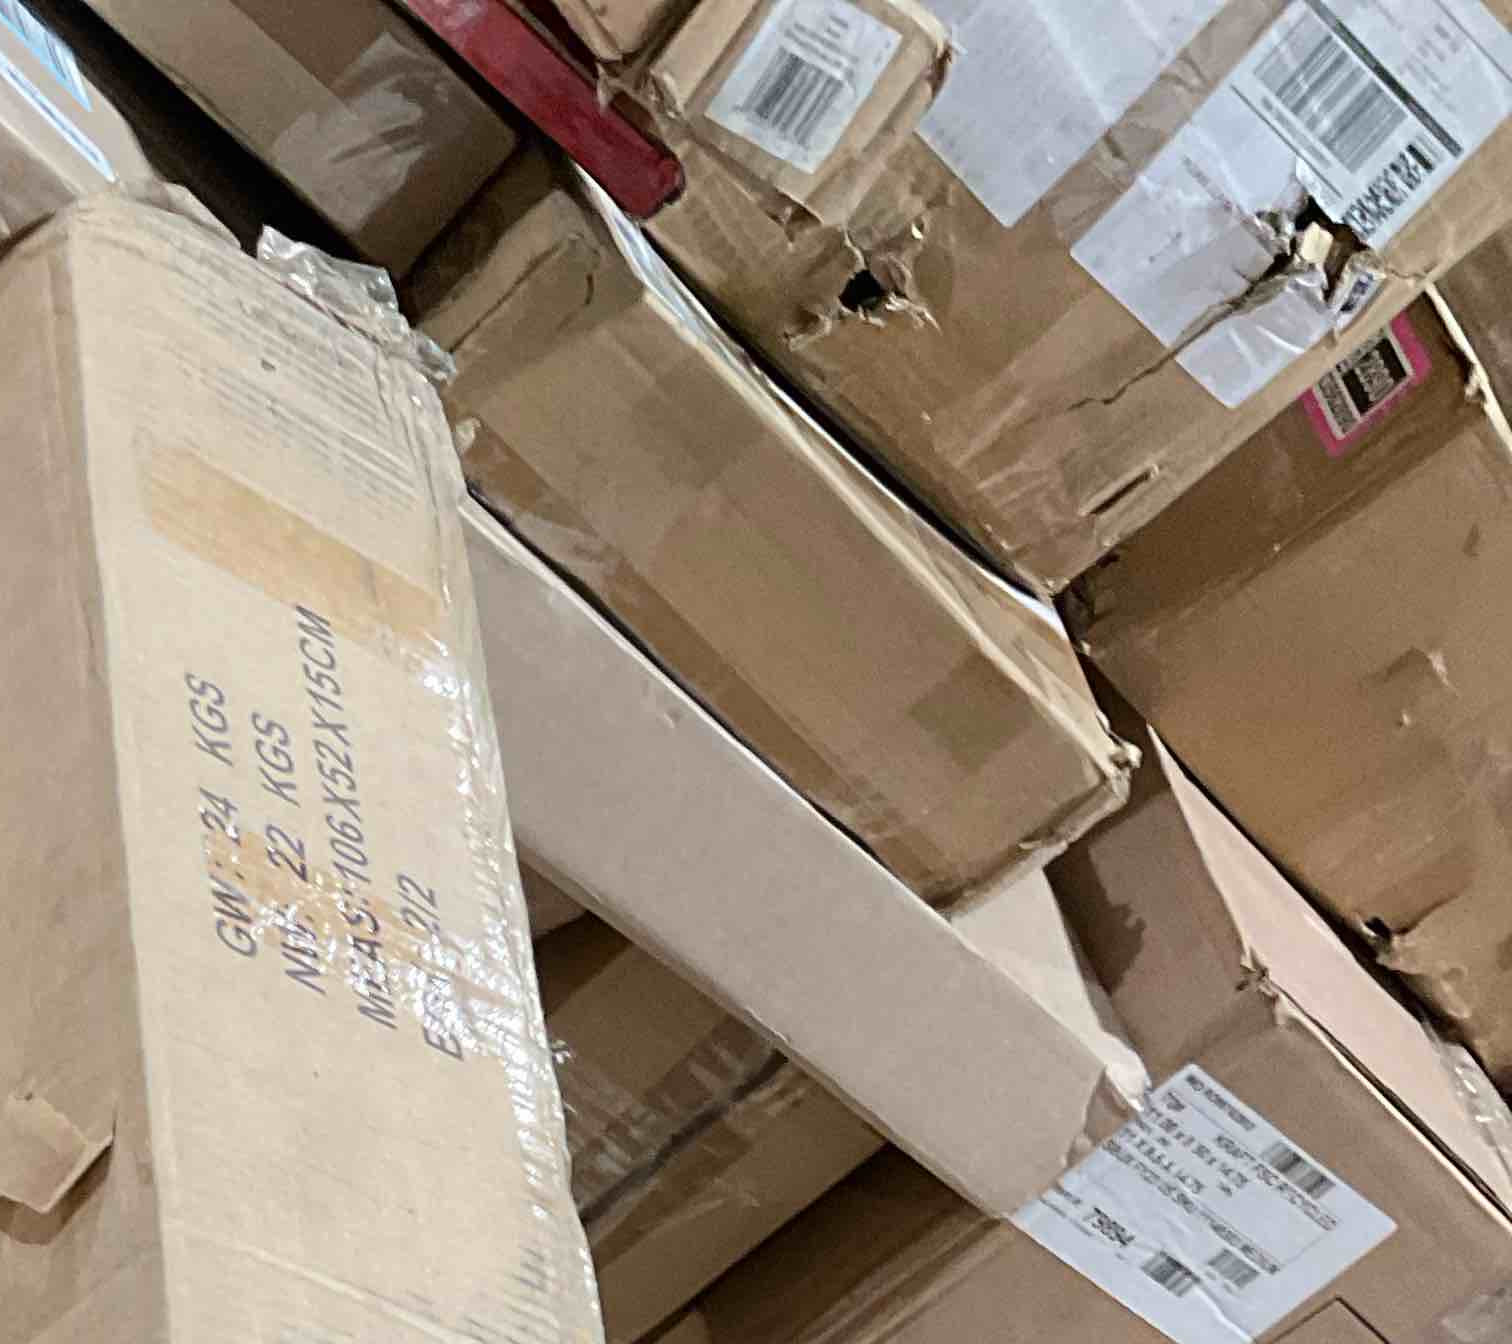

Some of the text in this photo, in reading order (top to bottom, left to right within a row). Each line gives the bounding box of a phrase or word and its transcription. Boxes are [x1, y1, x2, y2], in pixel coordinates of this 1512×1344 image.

[185, 671, 233, 767] KGS
[252, 712, 300, 809] KGS
[199, 786, 241, 846] 24
[265, 824, 308, 883] 22
